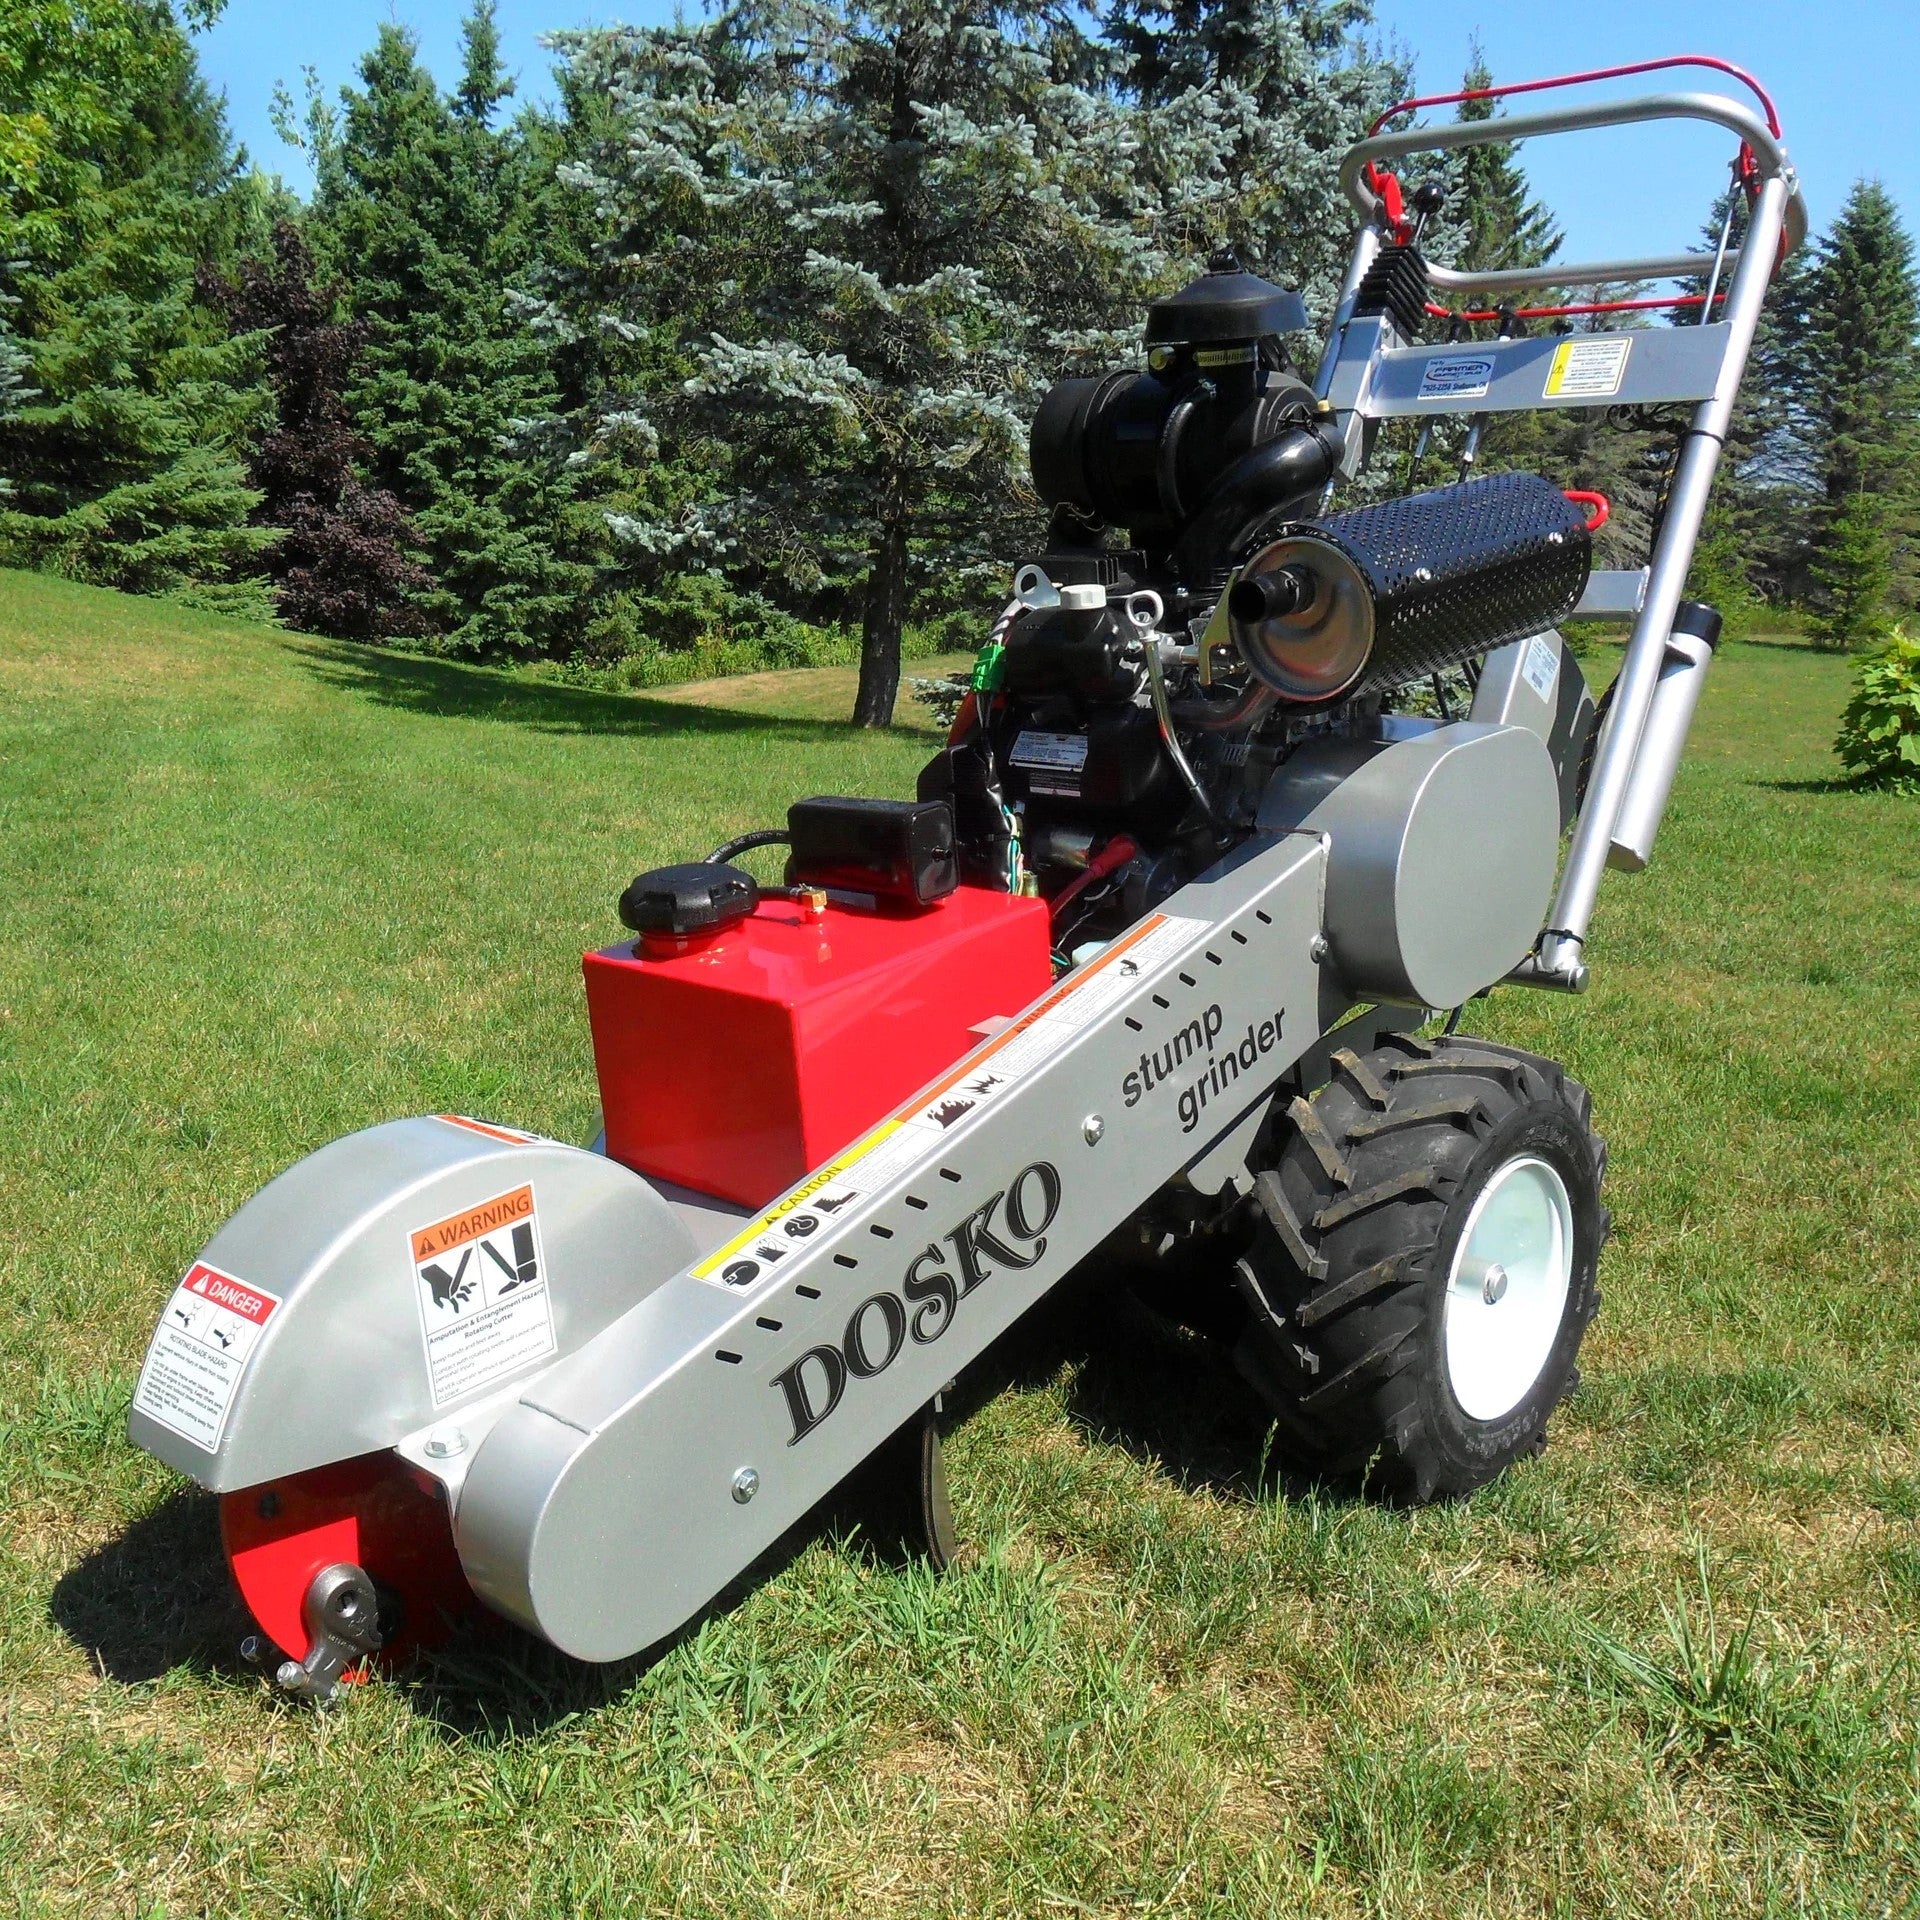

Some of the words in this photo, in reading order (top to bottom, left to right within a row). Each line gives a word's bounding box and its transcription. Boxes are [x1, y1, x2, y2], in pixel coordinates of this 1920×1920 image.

[1122, 1004, 1222, 1108] stump
[1178, 1007, 1285, 1133] grinder
[780, 1166, 842, 1211] CAUTION
[439, 1194, 530, 1245] WARNING
[208, 1280, 262, 1316] DANGER
[429, 1321, 468, 1345] Amputation
[469, 1318, 474, 1326] &
[475, 1297, 520, 1324] Entanglement
[521, 1286, 544, 1302] Hazard
[769, 1161, 1062, 1447] DOSKO
[464, 1320, 492, 1340] Rotating
[493, 1310, 513, 1325] Cutter
[168, 1333, 192, 1350] ROTATING
[191, 1345, 207, 1359] BLADE
[206, 1353, 228, 1370] HAZARD
